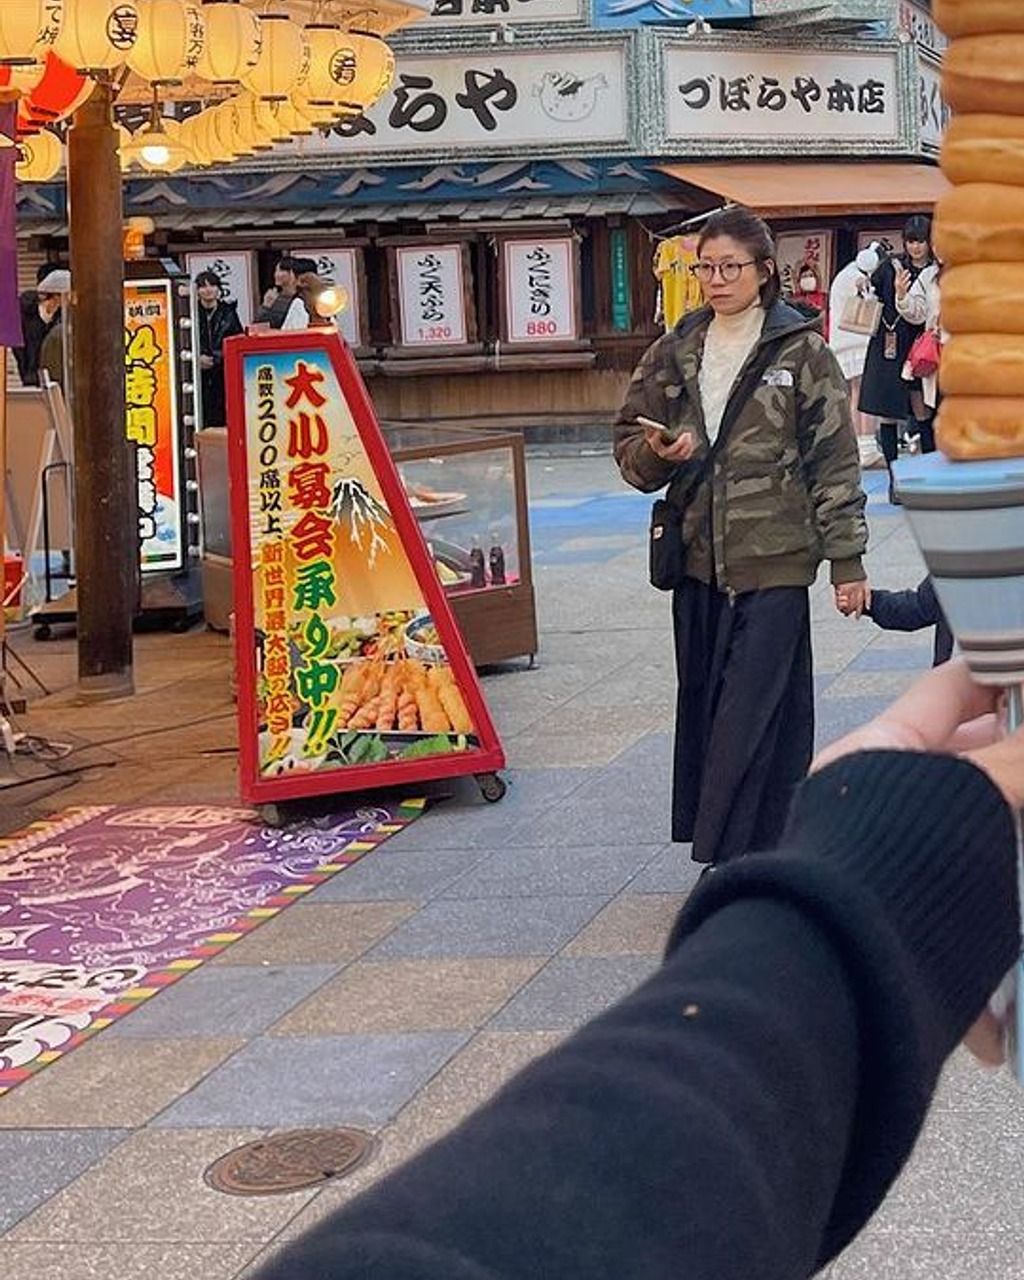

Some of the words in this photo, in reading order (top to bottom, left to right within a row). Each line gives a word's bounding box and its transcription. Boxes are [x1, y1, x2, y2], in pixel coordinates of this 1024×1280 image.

[678, 76, 886, 114] づぼらや本店
[527, 321, 557, 335] 880
